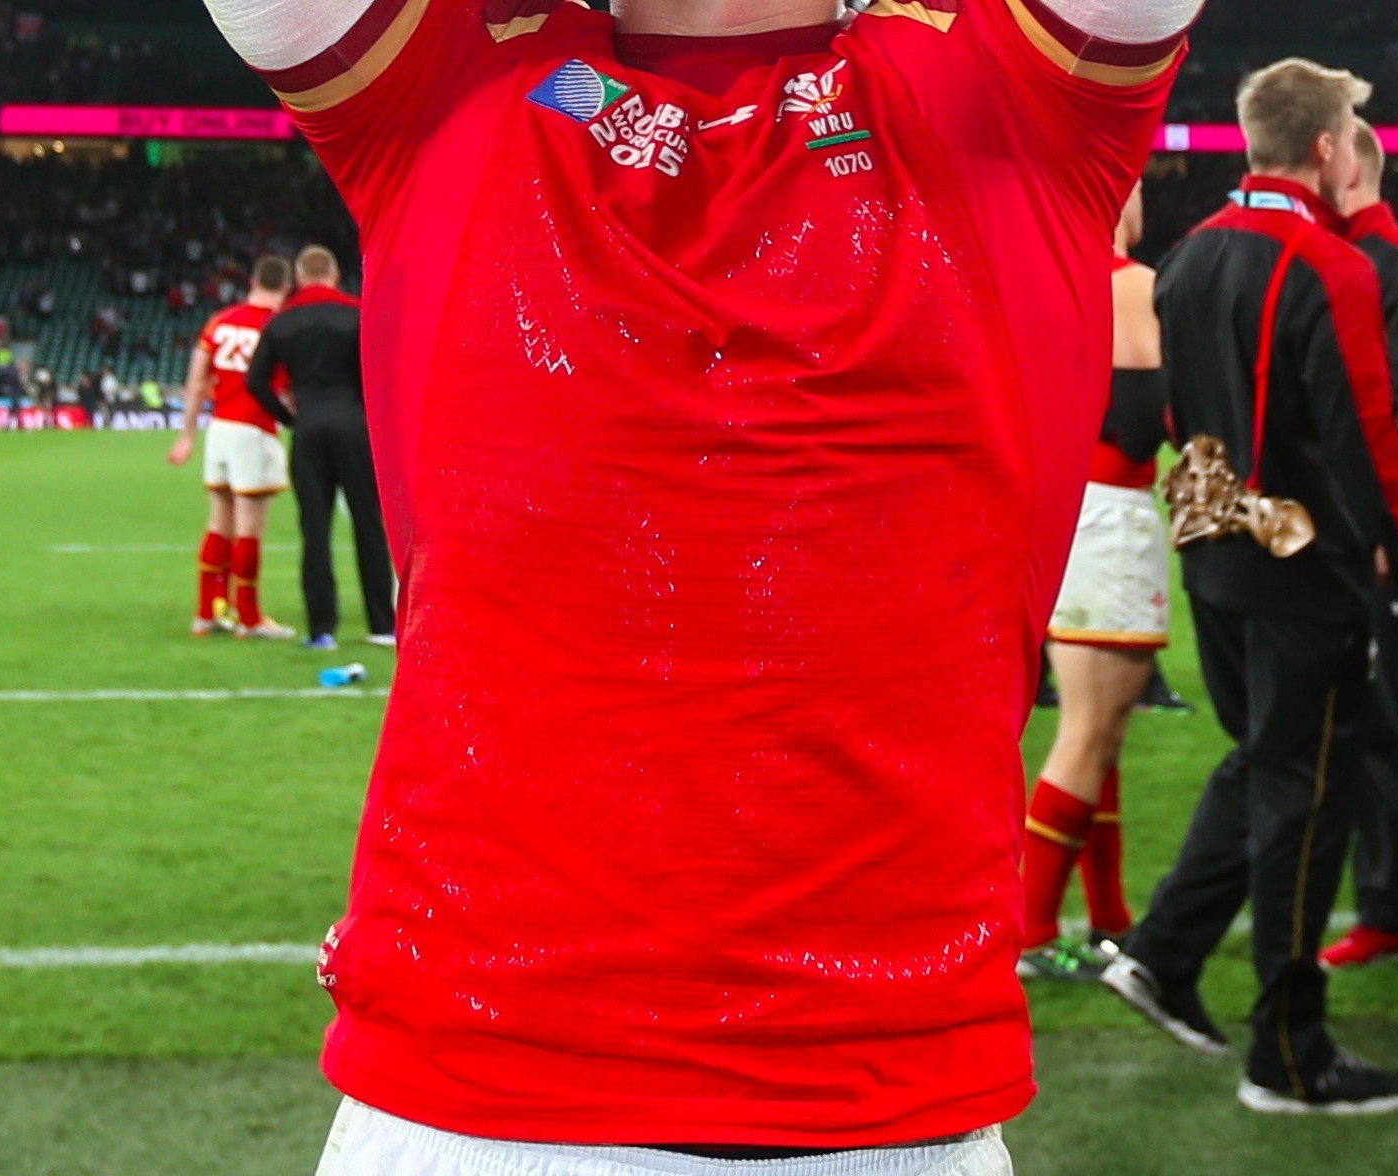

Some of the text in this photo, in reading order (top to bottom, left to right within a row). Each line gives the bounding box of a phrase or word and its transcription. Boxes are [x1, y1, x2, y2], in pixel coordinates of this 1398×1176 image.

[808, 111, 854, 137] WRU
[825, 151, 873, 177] 1070
[213, 325, 261, 373] 23
